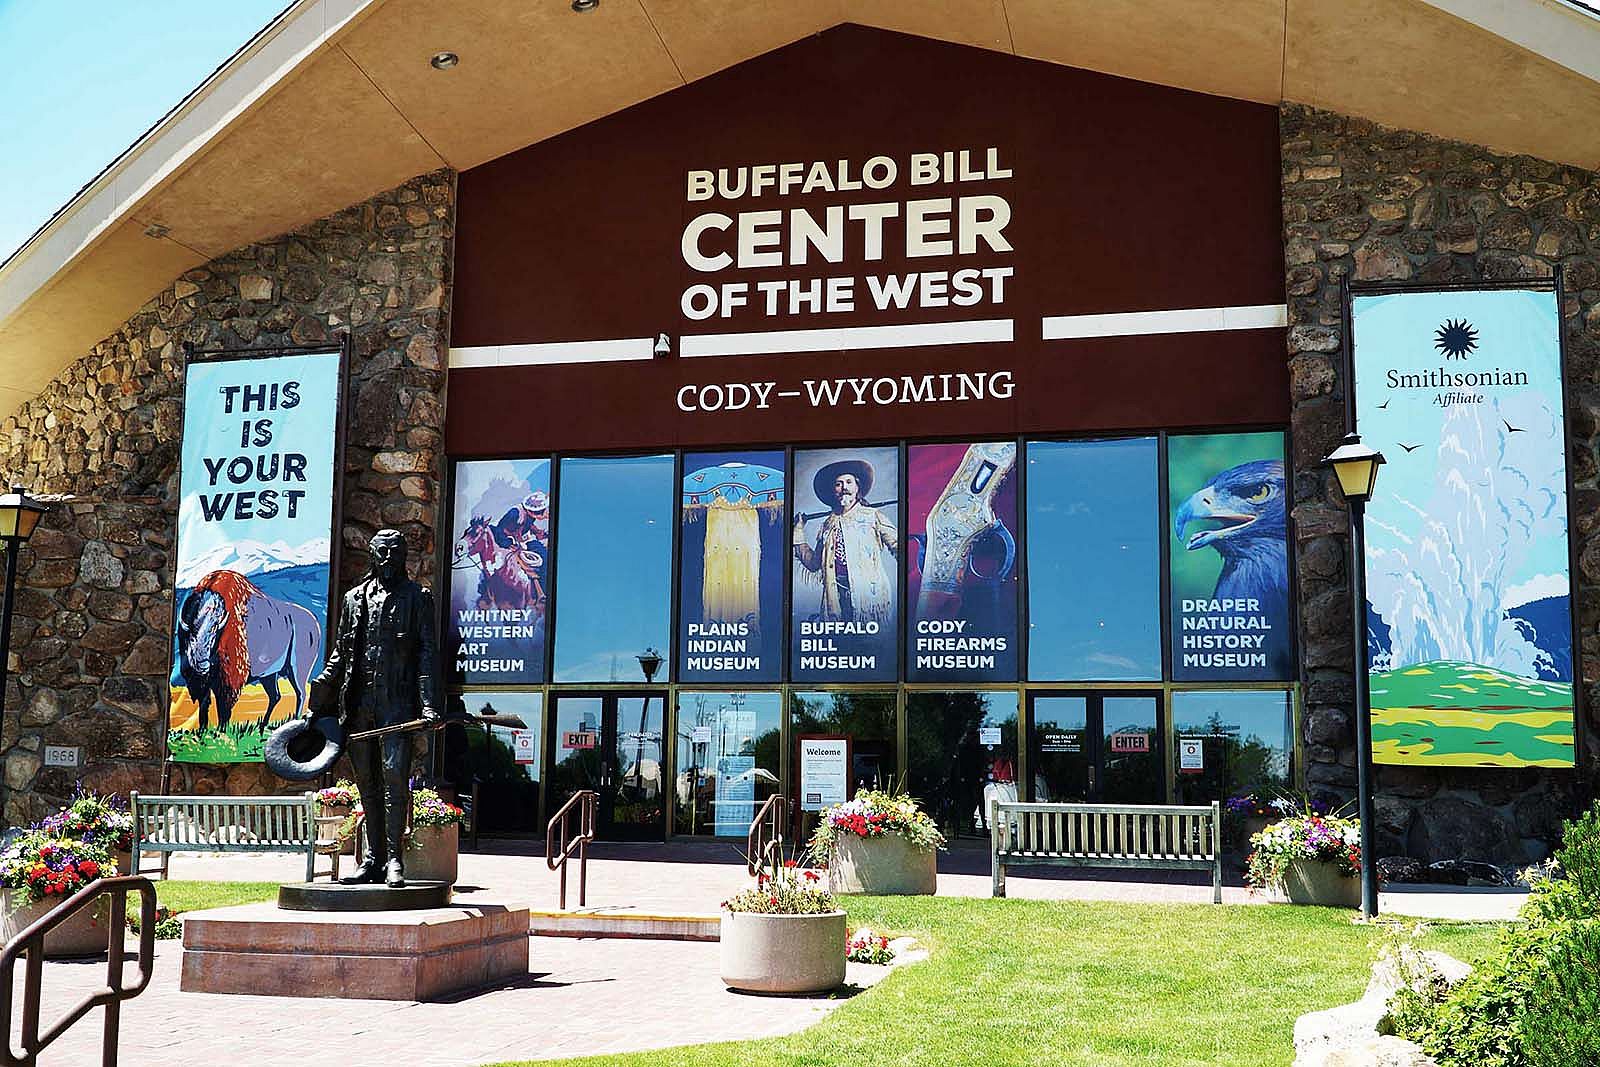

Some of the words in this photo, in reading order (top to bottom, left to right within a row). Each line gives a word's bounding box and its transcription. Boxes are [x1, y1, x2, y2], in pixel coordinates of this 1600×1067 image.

[687, 156, 898, 201] BUFFALO
[910, 147, 1013, 186] BILL
[681, 195, 1014, 272] CENTER
[680, 283, 748, 320] OF
[757, 277, 854, 316] THE
[866, 267, 1014, 310] WEST
[1386, 367, 1528, 389] Smithsonian
[219, 381, 301, 414] THIS
[1432, 392, 1484, 408] Affiliate
[241, 418, 273, 448] IS
[203, 453, 307, 486] YOUR
[199, 490, 306, 522] WEST
[1182, 598, 1259, 613] DRAPER
[459, 609, 532, 623] WHITNEY
[1182, 615, 1271, 630] NATURAL
[458, 625, 533, 639] WESTERN
[688, 623, 749, 636] PLAINS
[800, 621, 879, 635] BUFFALO
[916, 620, 966, 634] CODY
[688, 639, 746, 653] INDIAN
[801, 637, 837, 652] BILL
[916, 637, 1006, 651] FIREARMS
[1183, 634, 1264, 649] HISTORY
[457, 643, 489, 655] ART
[456, 659, 524, 672] MUSEUM
[687, 657, 760, 670] MUSEUM
[800, 655, 875, 670] MUSEUM
[916, 655, 994, 669] MUSEUM
[1183, 653, 1266, 668] MUSEUM
[568, 734, 589, 745] EXIT
[1116, 736, 1145, 749] ENTER
[48, 750, 75, 762] 1968
[806, 748, 841, 756] Welcome
